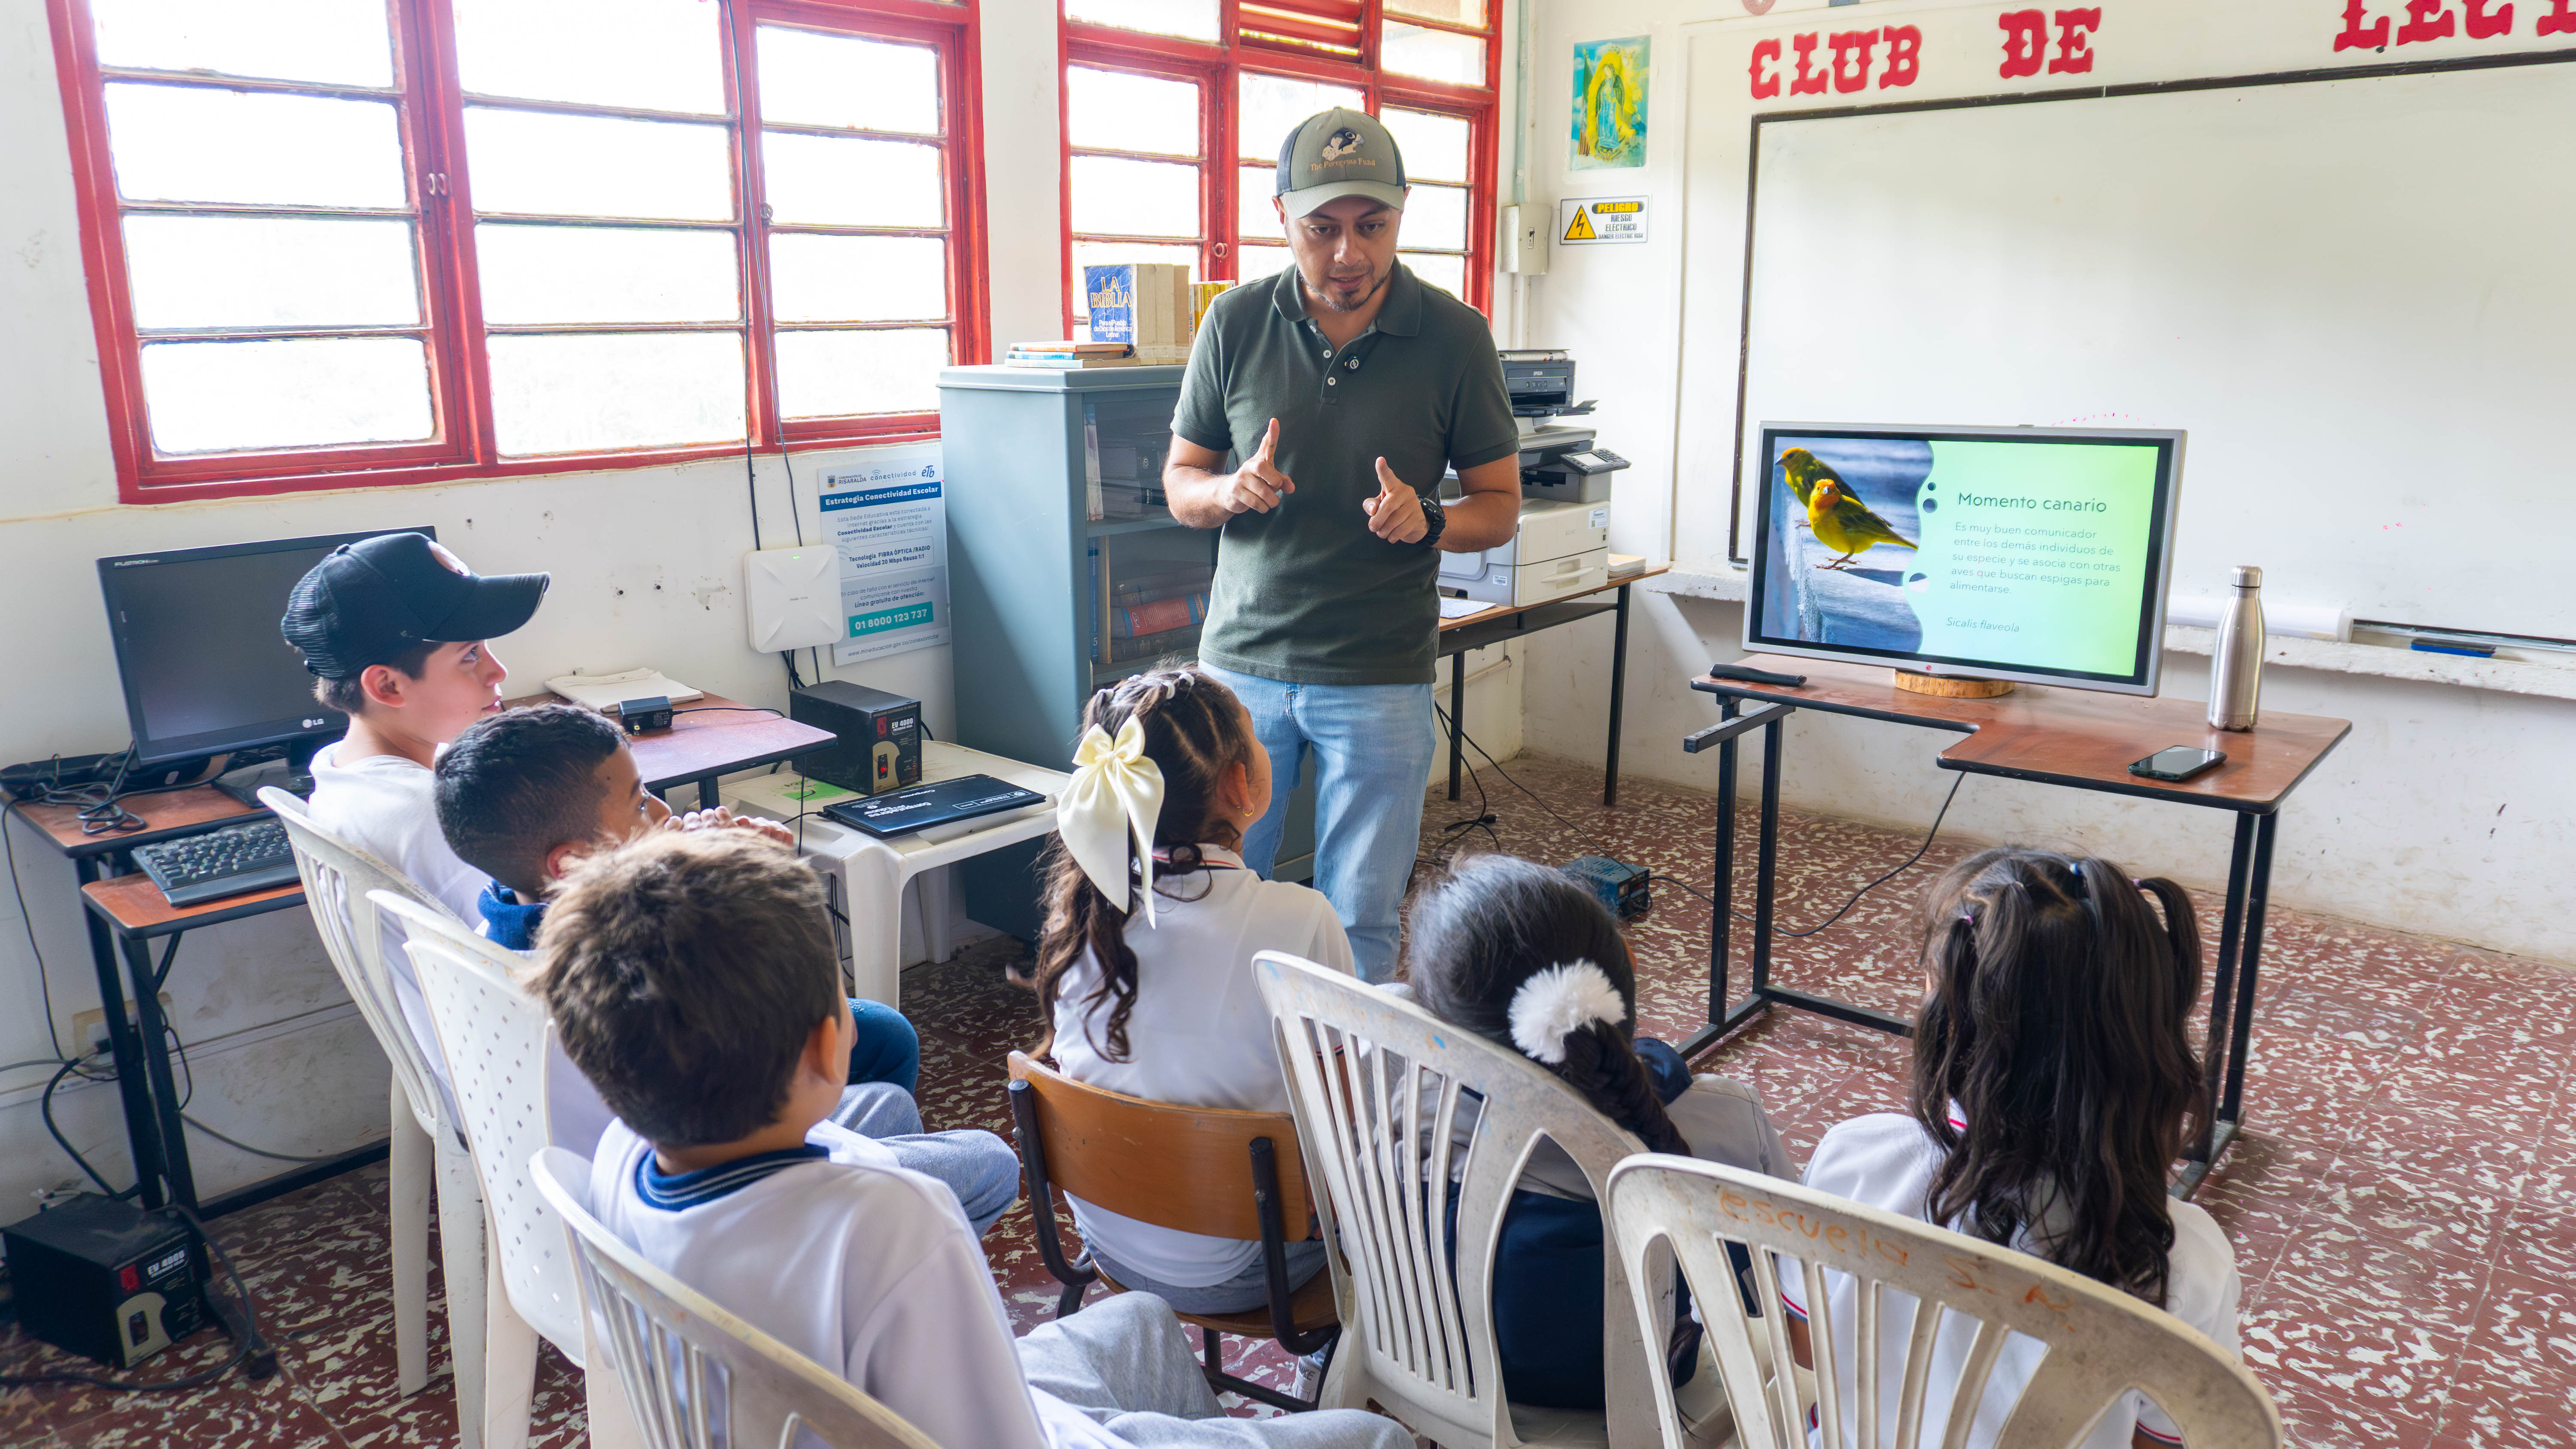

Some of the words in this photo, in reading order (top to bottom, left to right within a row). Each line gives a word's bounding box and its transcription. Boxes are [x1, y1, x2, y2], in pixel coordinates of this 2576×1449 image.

[1748, 24, 1922, 100] CLUB
[1999, 7, 2102, 79] DE
[1324, 160, 1357, 168] Peregrine
[1358, 158, 1376, 166] Fund
[1597, 202, 1638, 213] PELIGRO
[1611, 214, 1632, 222] RIESGO
[1100, 276, 1120, 292] LA
[1090, 291, 1133, 308] BIBLIA
[826, 495, 864, 505] Estrategia
[865, 489, 911, 500] Conectividad
[913, 486, 939, 495] Escolar
[1958, 491, 2037, 509] Momento
[2043, 497, 2107, 513] canario
[901, 506, 927, 514] conectada
[838, 527, 872, 536] Conectividad
[1955, 521, 1966, 531] Es
[1969, 525, 1992, 535] muy
[1995, 524, 2021, 534] buen
[2025, 527, 2097, 539] comunicador
[1954, 538, 1981, 547] entre
[1984, 539, 1999, 548] los
[2001, 540, 2036, 551] demás
[2039, 542, 2096, 554] individuos
[2099, 546, 2114, 555] de
[856, 560, 881, 569] Velocidad
[1967, 554, 2006, 565] especie
[2009, 558, 2015, 566] y
[2033, 558, 2066, 568] asocia
[2070, 561, 2090, 570] con
[2093, 562, 2121, 572] otras
[1951, 568, 1974, 576] aves
[1977, 570, 1996, 581] que
[2000, 569, 2037, 581] buscan
[2041, 573, 2082, 585] espigas
[2085, 577, 2110, 587] para
[1950, 581, 2012, 594] alimentarse.
[855, 621, 866, 630] 01
[868, 615, 892, 627] 8000
[893, 612, 909, 623] 123
[911, 609, 927, 619] 737
[1946, 617, 1977, 629] Sicalis
[1980, 620, 2020, 633] flaveola
[1093, 637, 1098, 646] 5
[899, 717, 914, 727] 4000
[868, 802, 932, 818] Computadores
[1719, 1188, 1908, 1267] escuela
